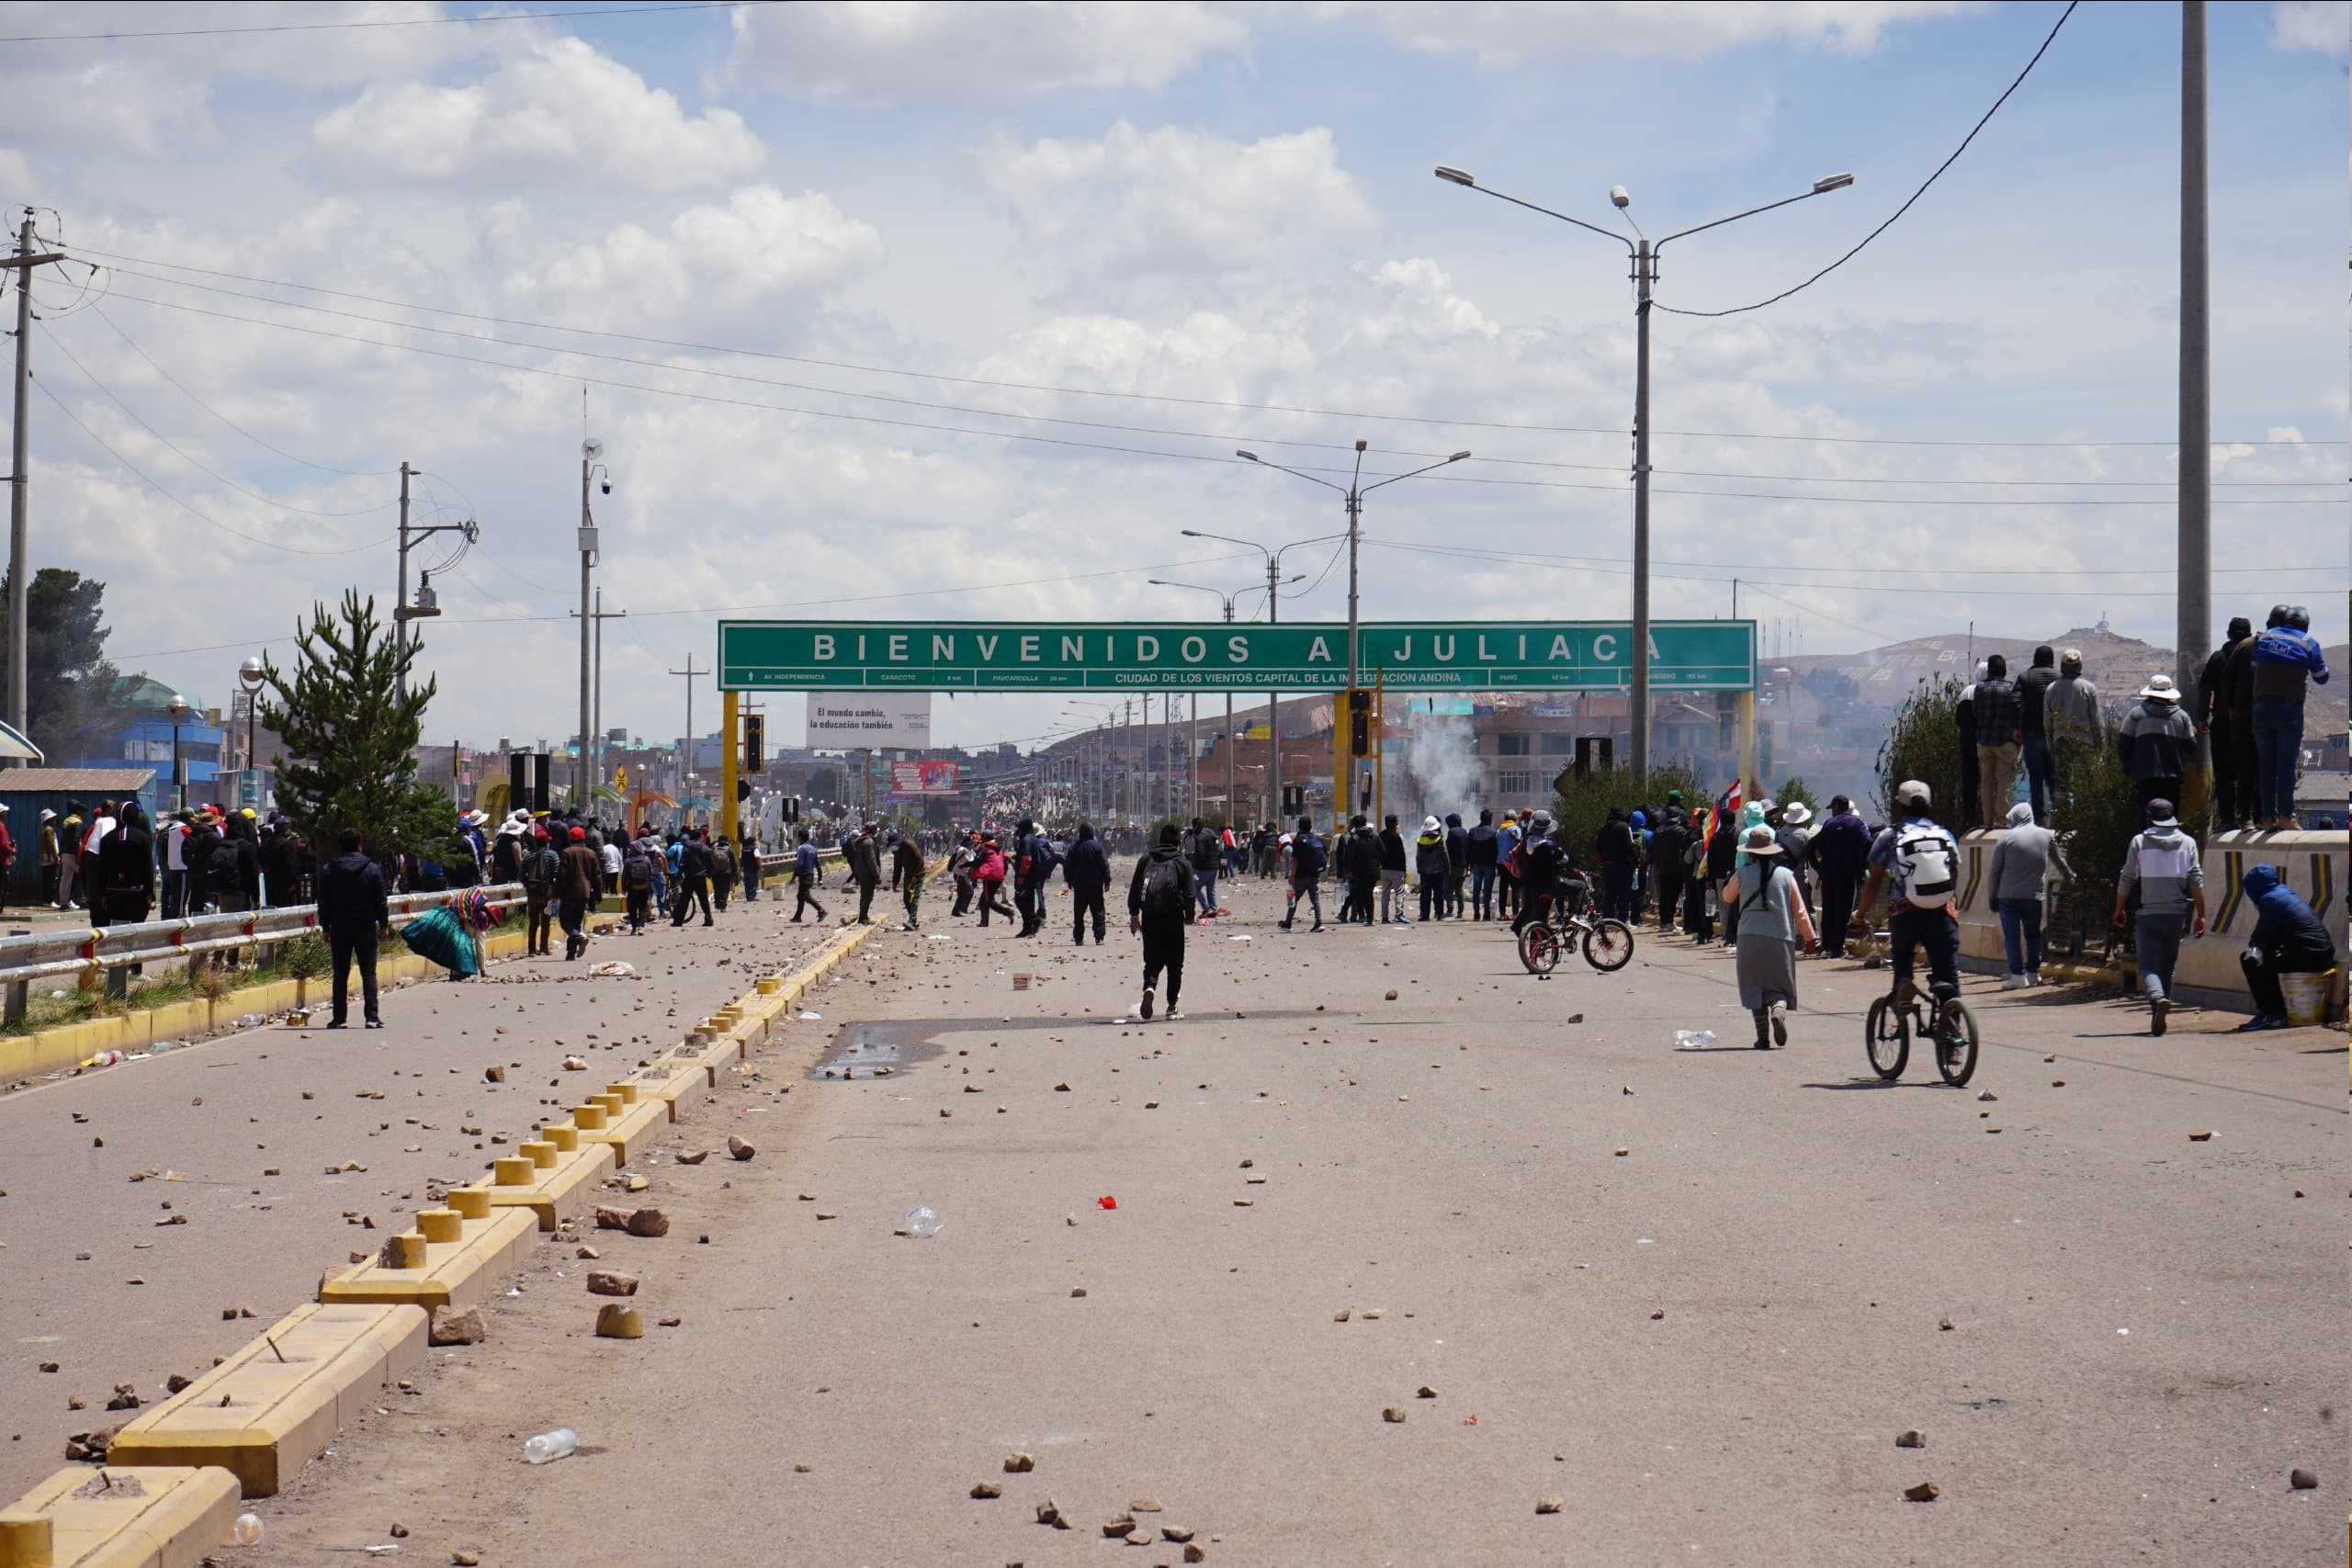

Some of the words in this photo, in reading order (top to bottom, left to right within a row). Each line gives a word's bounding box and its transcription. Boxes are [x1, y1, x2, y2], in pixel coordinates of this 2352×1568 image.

[814, 635, 1249, 662] BIENVENIDOS
[1307, 636, 1332, 661] A
[1114, 673, 1158, 683] CIUDAD
[1162, 673, 1177, 682] DE
[1180, 673, 1202, 683] LOS
[1204, 673, 1252, 683] VIENTOS
[1255, 673, 1301, 683] CAPITAL
[1304, 673, 1319, 683] DE
[1322, 673, 1336, 683] LA
[1339, 672, 1416, 682] INEGACION
[1419, 672, 1461, 682] ANDINA
[817, 707, 825, 716] El
[827, 708, 854, 717] mundo
[854, 708, 887, 719] cambia,
[809, 719, 818, 728] la
[820, 719, 860, 729] educación
[862, 719, 893, 729] también
